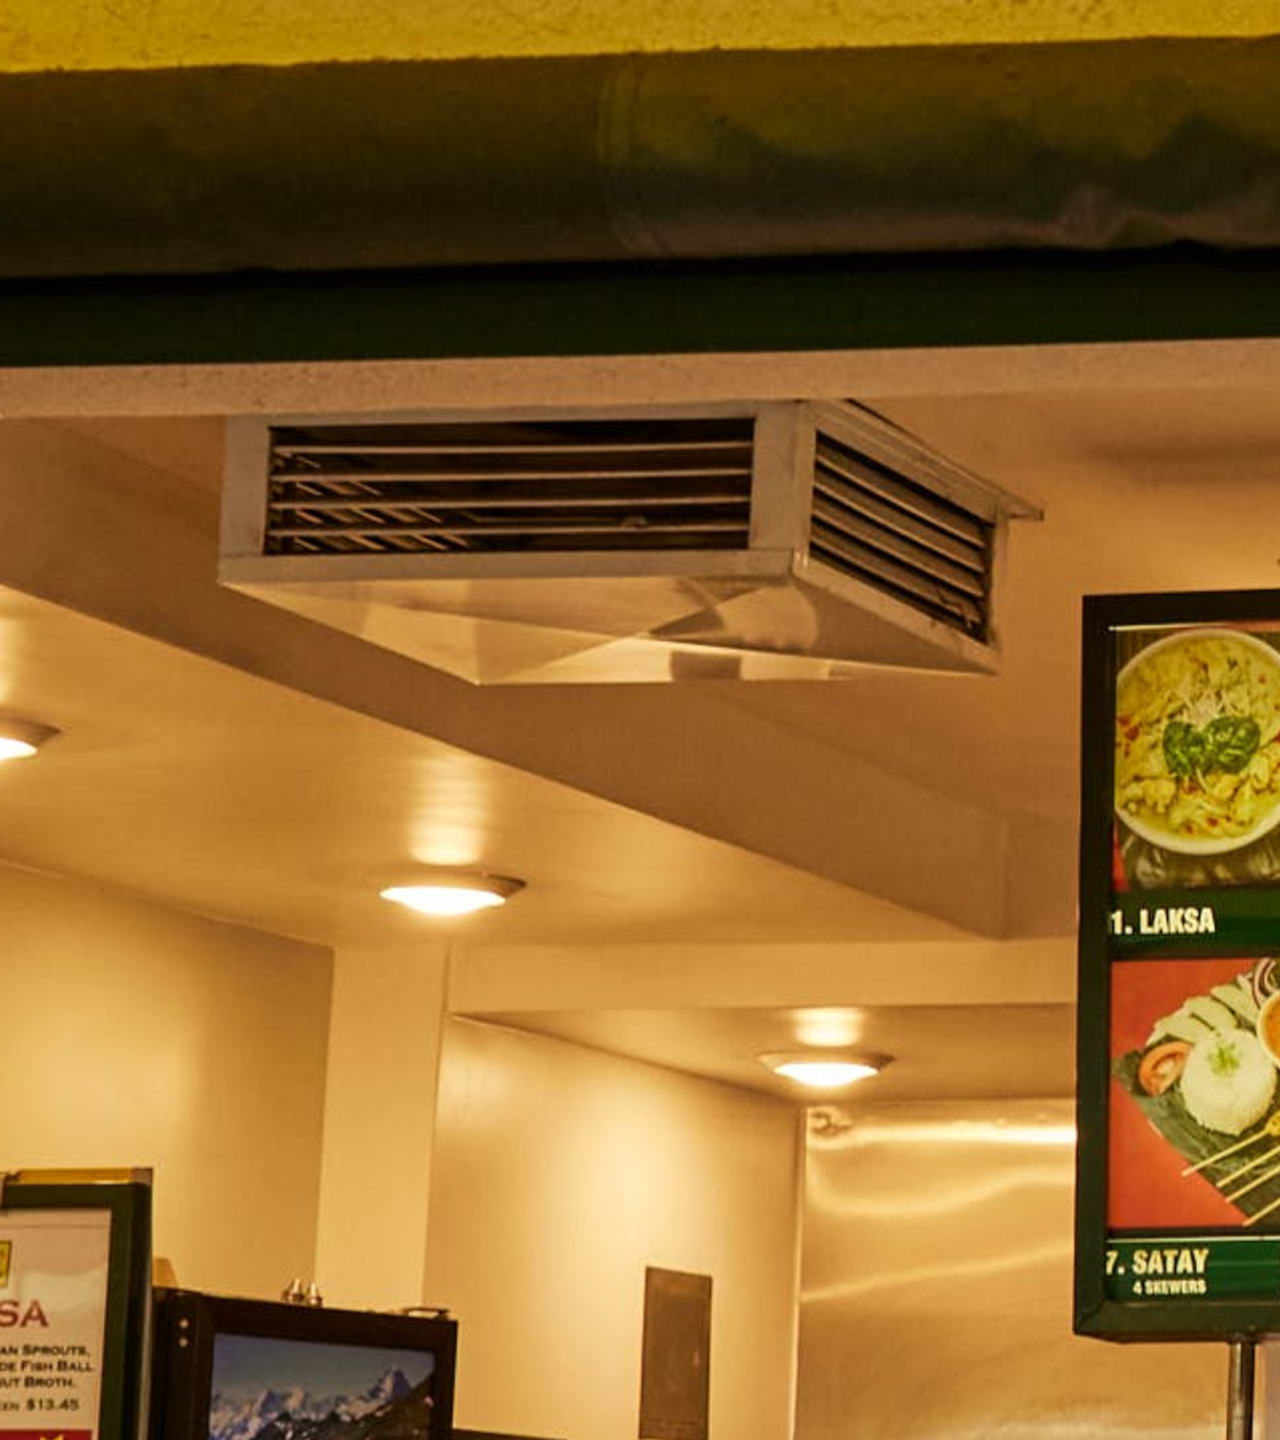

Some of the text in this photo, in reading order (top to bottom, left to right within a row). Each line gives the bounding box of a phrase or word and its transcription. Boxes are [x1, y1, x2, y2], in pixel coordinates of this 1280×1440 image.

[1111, 908, 1216, 935] 1. LAKSA
[1106, 1249, 1209, 1275] 7. SATAY
